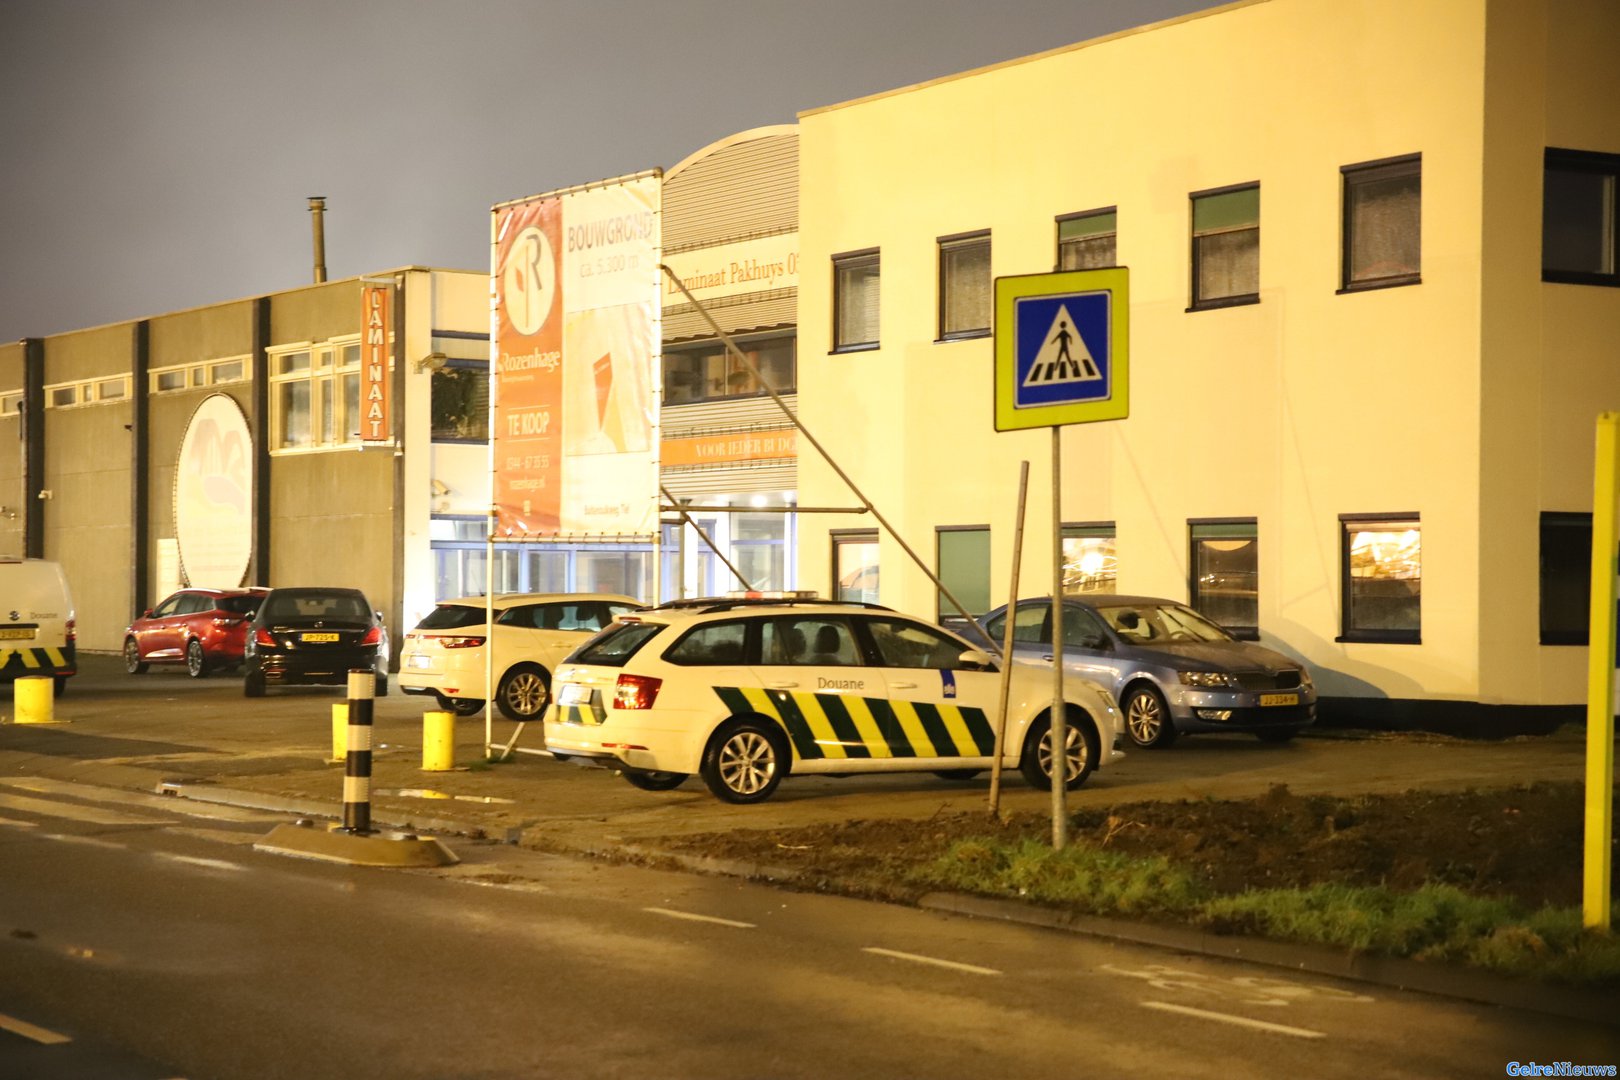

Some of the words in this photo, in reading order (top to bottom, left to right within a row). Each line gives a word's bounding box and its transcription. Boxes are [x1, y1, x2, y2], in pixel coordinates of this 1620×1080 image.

[568, 211, 653, 253] BOUWGROND
[730, 258, 784, 285] Pakhuys
[367, 291, 384, 437] LAMINAAT
[499, 347, 561, 373] Rozenhage
[507, 414, 520, 436] TE
[522, 411, 550, 435] KOOP
[696, 442, 726, 457] VOOR
[817, 676, 865, 690] Douane
